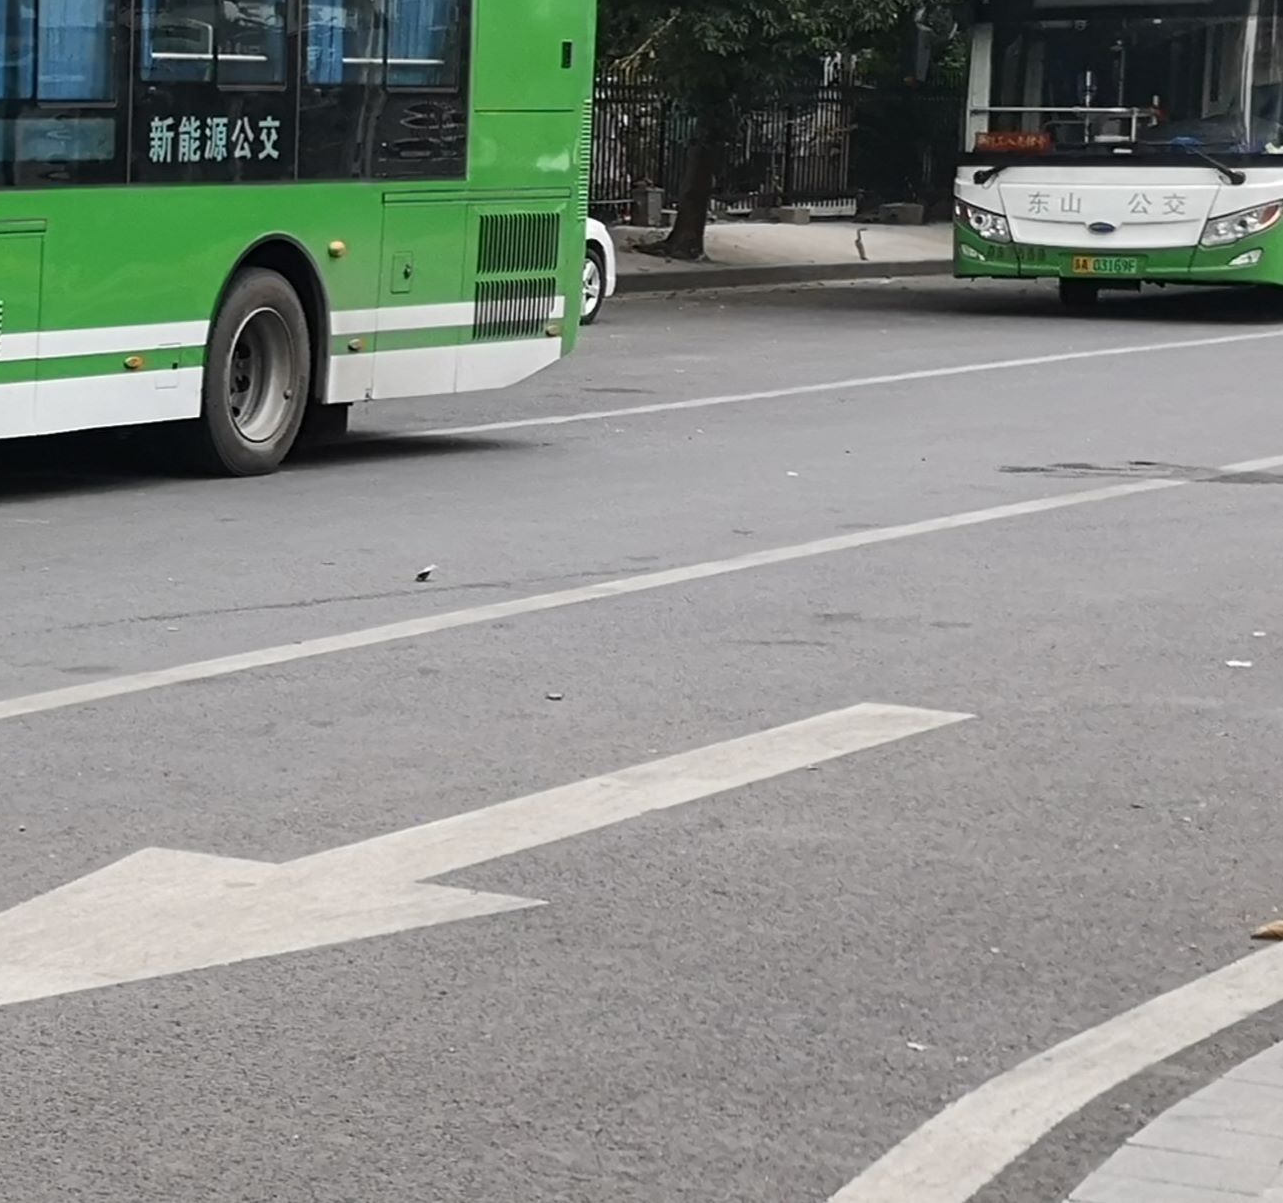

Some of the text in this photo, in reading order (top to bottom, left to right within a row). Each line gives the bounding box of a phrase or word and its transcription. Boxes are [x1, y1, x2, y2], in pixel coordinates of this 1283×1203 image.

[148, 115, 281, 164] 新能源公交
[1027, 191, 1188, 216] 东山 公交
